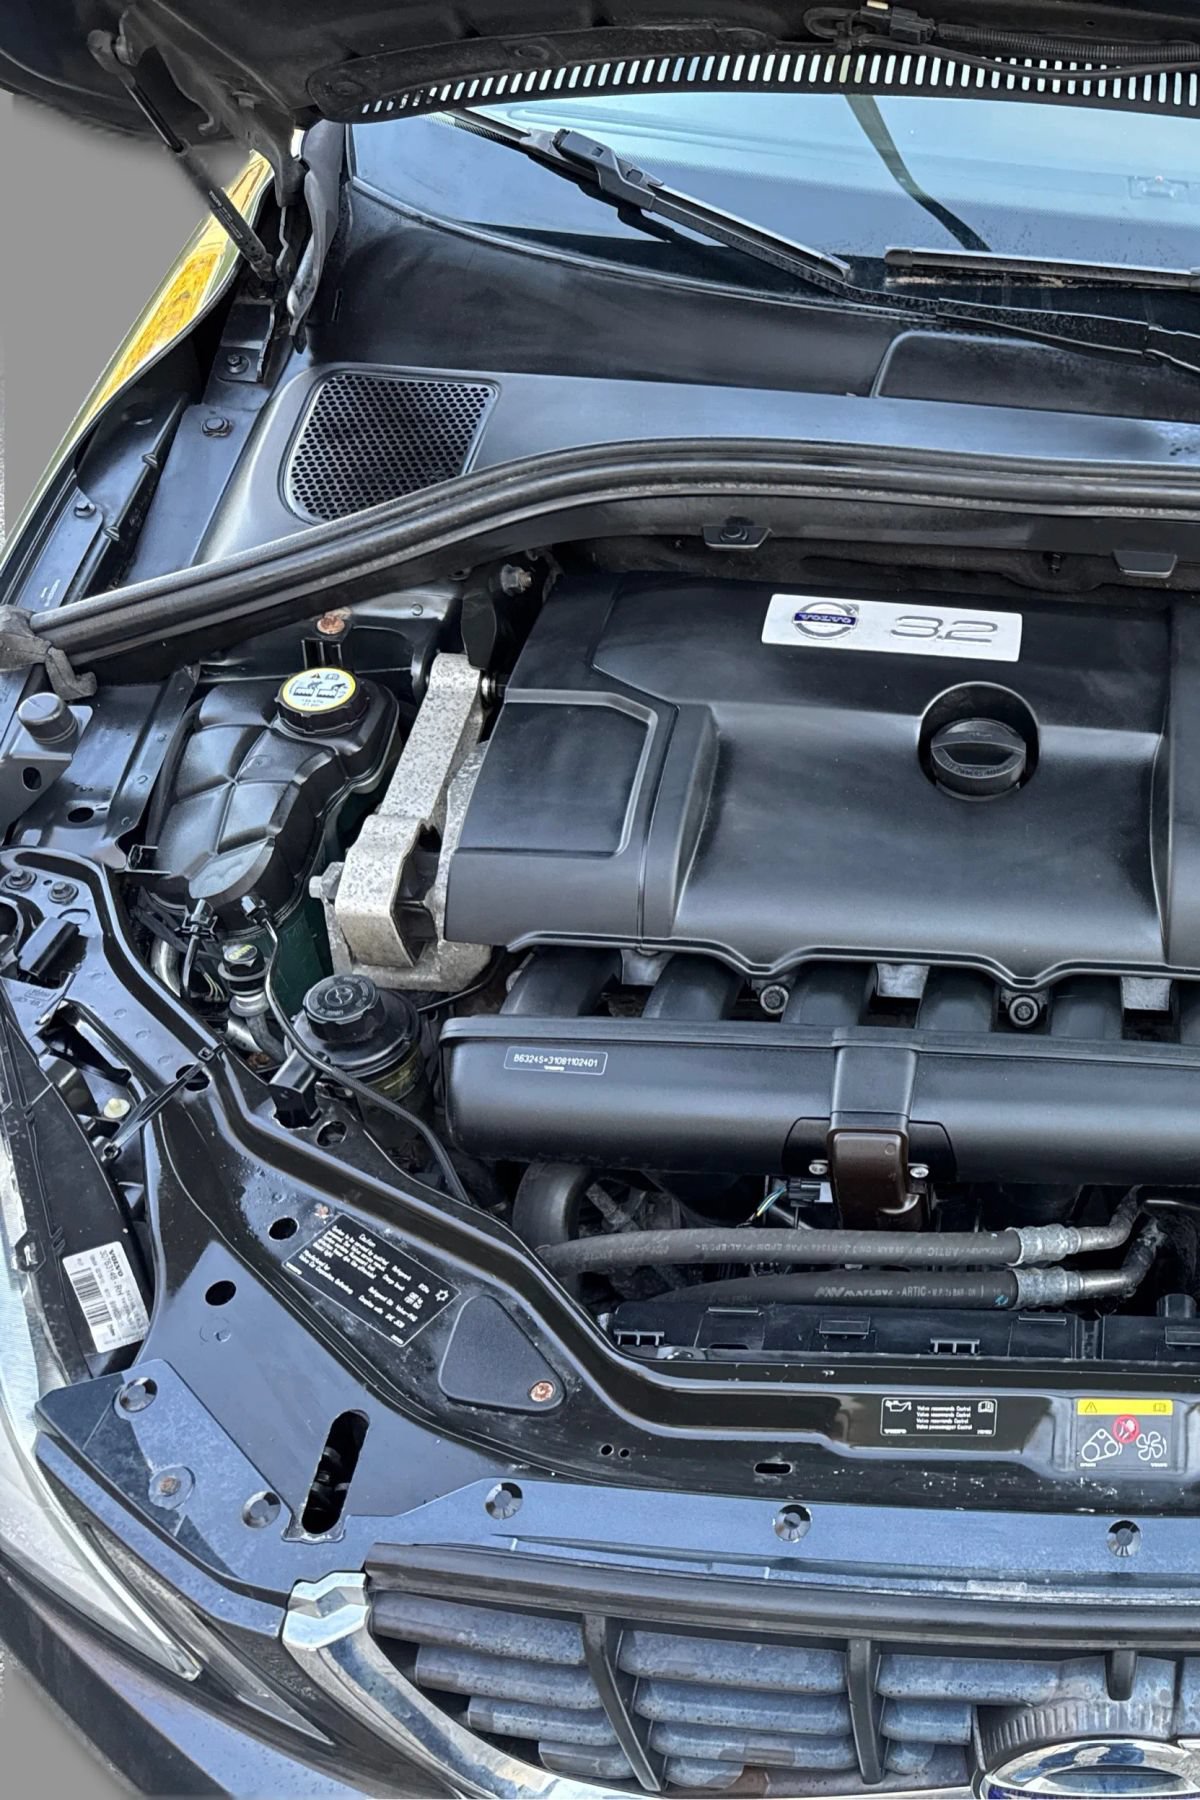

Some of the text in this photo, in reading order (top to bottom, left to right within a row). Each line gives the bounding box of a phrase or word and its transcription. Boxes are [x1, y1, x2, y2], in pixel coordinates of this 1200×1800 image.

[799, 614, 852, 624] VOLVO
[890, 615, 998, 643] 3.2
[109, 1248, 124, 1277] VOLVO
[901, 1286, 927, 1297] ARTIC
